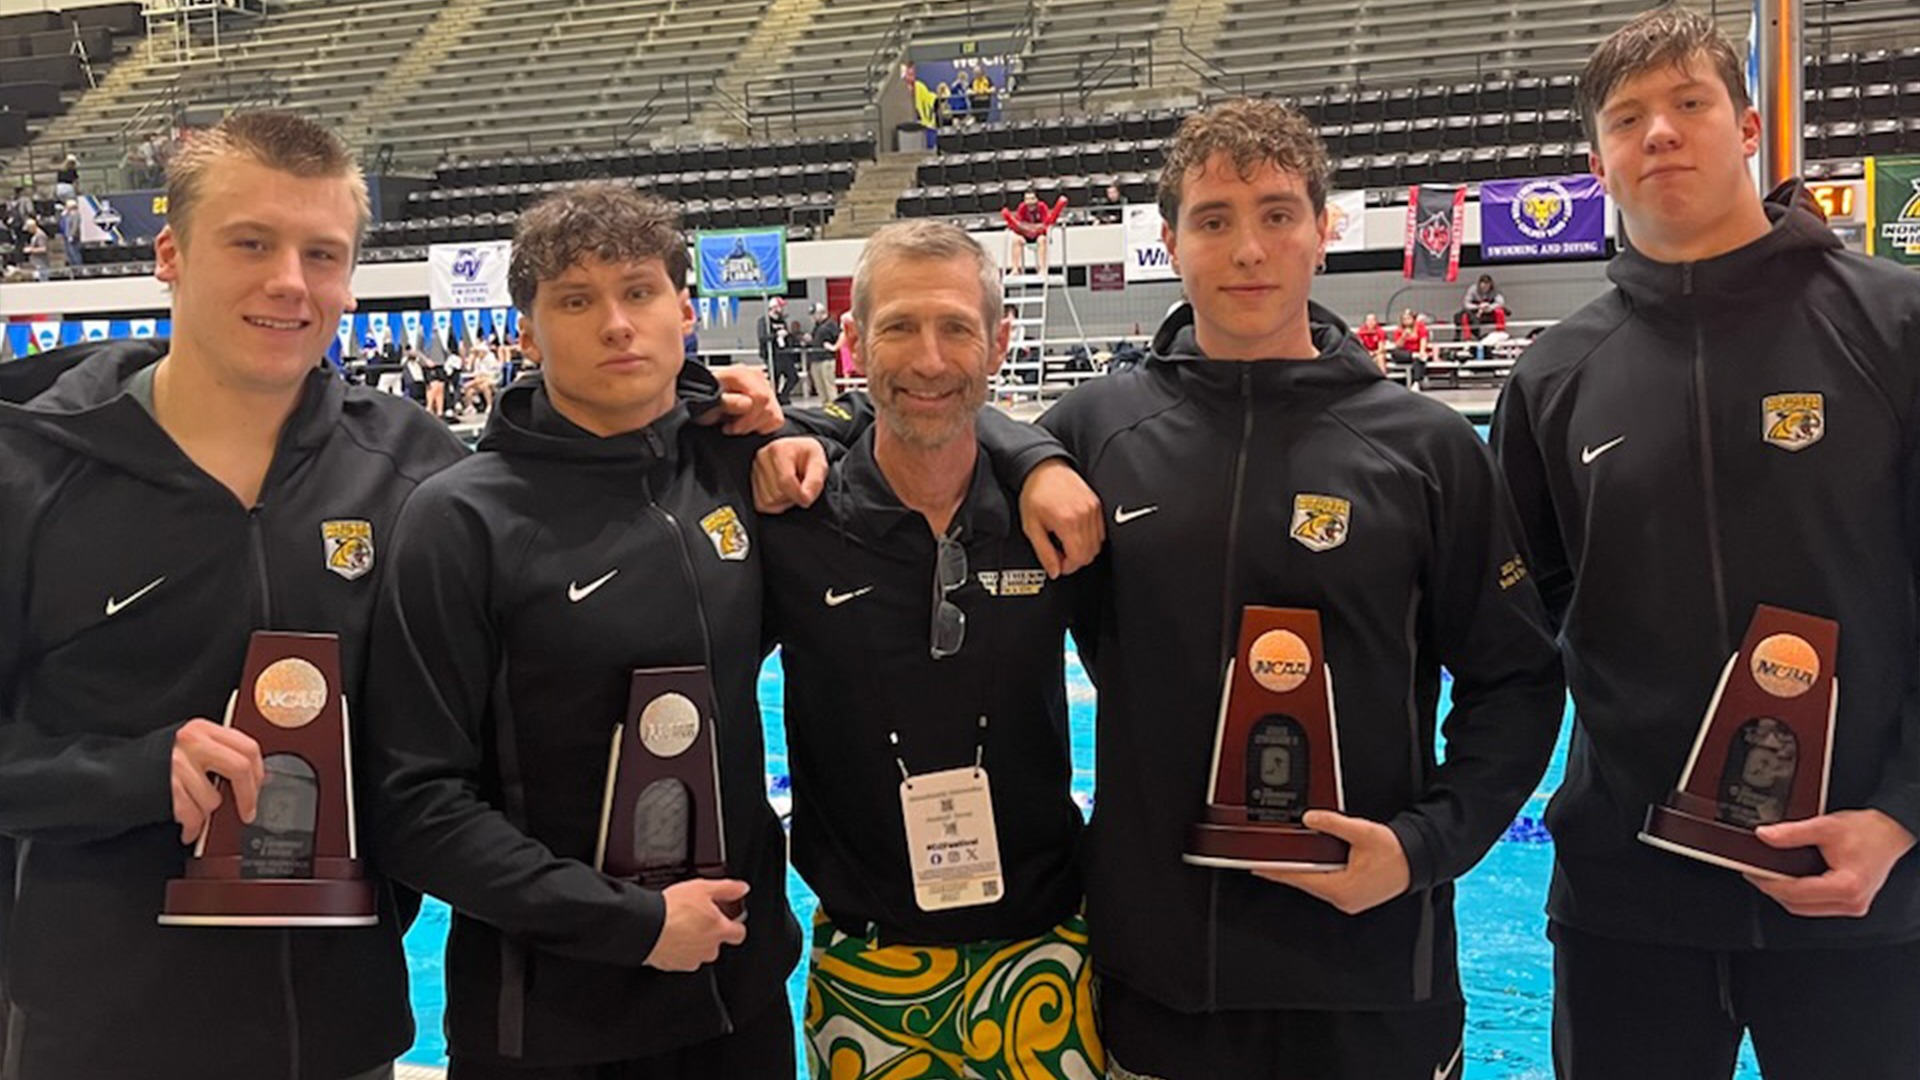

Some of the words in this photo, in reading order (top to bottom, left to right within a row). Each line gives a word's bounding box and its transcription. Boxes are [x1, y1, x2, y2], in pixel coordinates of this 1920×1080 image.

[1541, 243, 1561, 255] AND
[1254, 660, 1307, 676] NCAA
[1757, 660, 1813, 684] NCAA
[261, 692, 322, 710] NCAA
